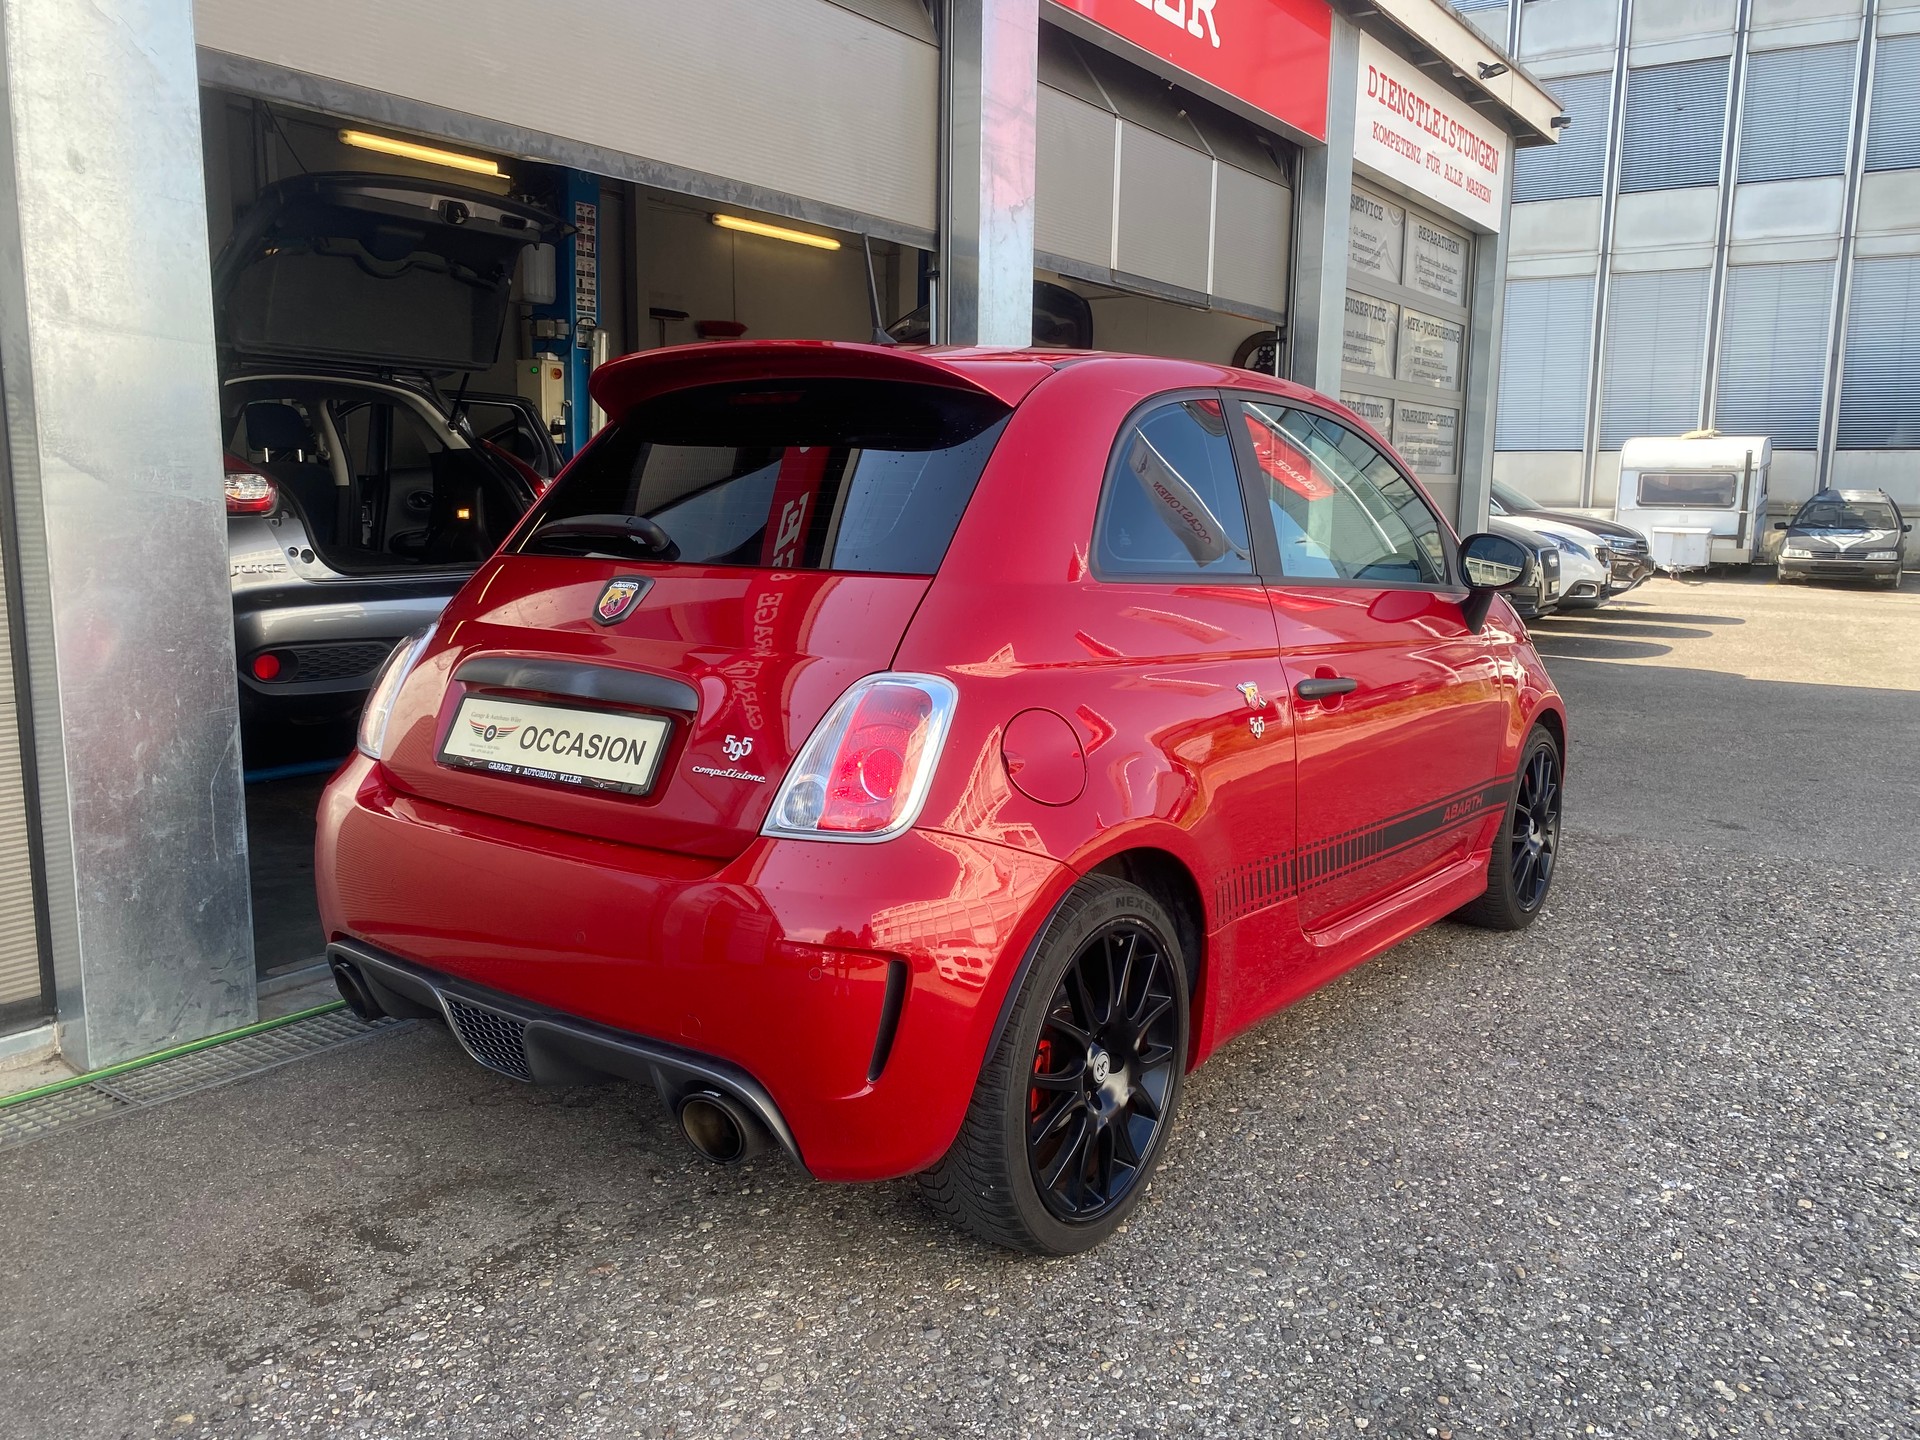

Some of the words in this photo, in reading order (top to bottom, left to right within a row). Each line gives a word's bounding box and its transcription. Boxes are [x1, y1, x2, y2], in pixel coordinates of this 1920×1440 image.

[1367, 65, 1499, 175] DIENSTLEISTUNGEN
[1372, 121, 1422, 165] KOMPETENZ
[1425, 150, 1441, 176] FÜR
[1444, 163, 1463, 188] ALLE
[1465, 176, 1492, 204] MARKEN
[1350, 193, 1383, 221] SERVICE
[1418, 225, 1460, 255] REPARATUREN
[1344, 296, 1387, 323] EUSERVICE
[1340, 399, 1384, 419] BEREITUNG
[230, 563, 287, 577] JUKE
[1249, 716, 1265, 739] 595
[519, 725, 647, 766] OCCASION
[722, 734, 754, 761] 595
[488, 761, 513, 773] GARAGE
[522, 768, 556, 780] AUTOHAUS
[559, 773, 582, 784] WILER
[692, 765, 766, 783] competizione
[1442, 793, 1484, 823] ABARTH
[1115, 896, 1161, 921] NEXEN
